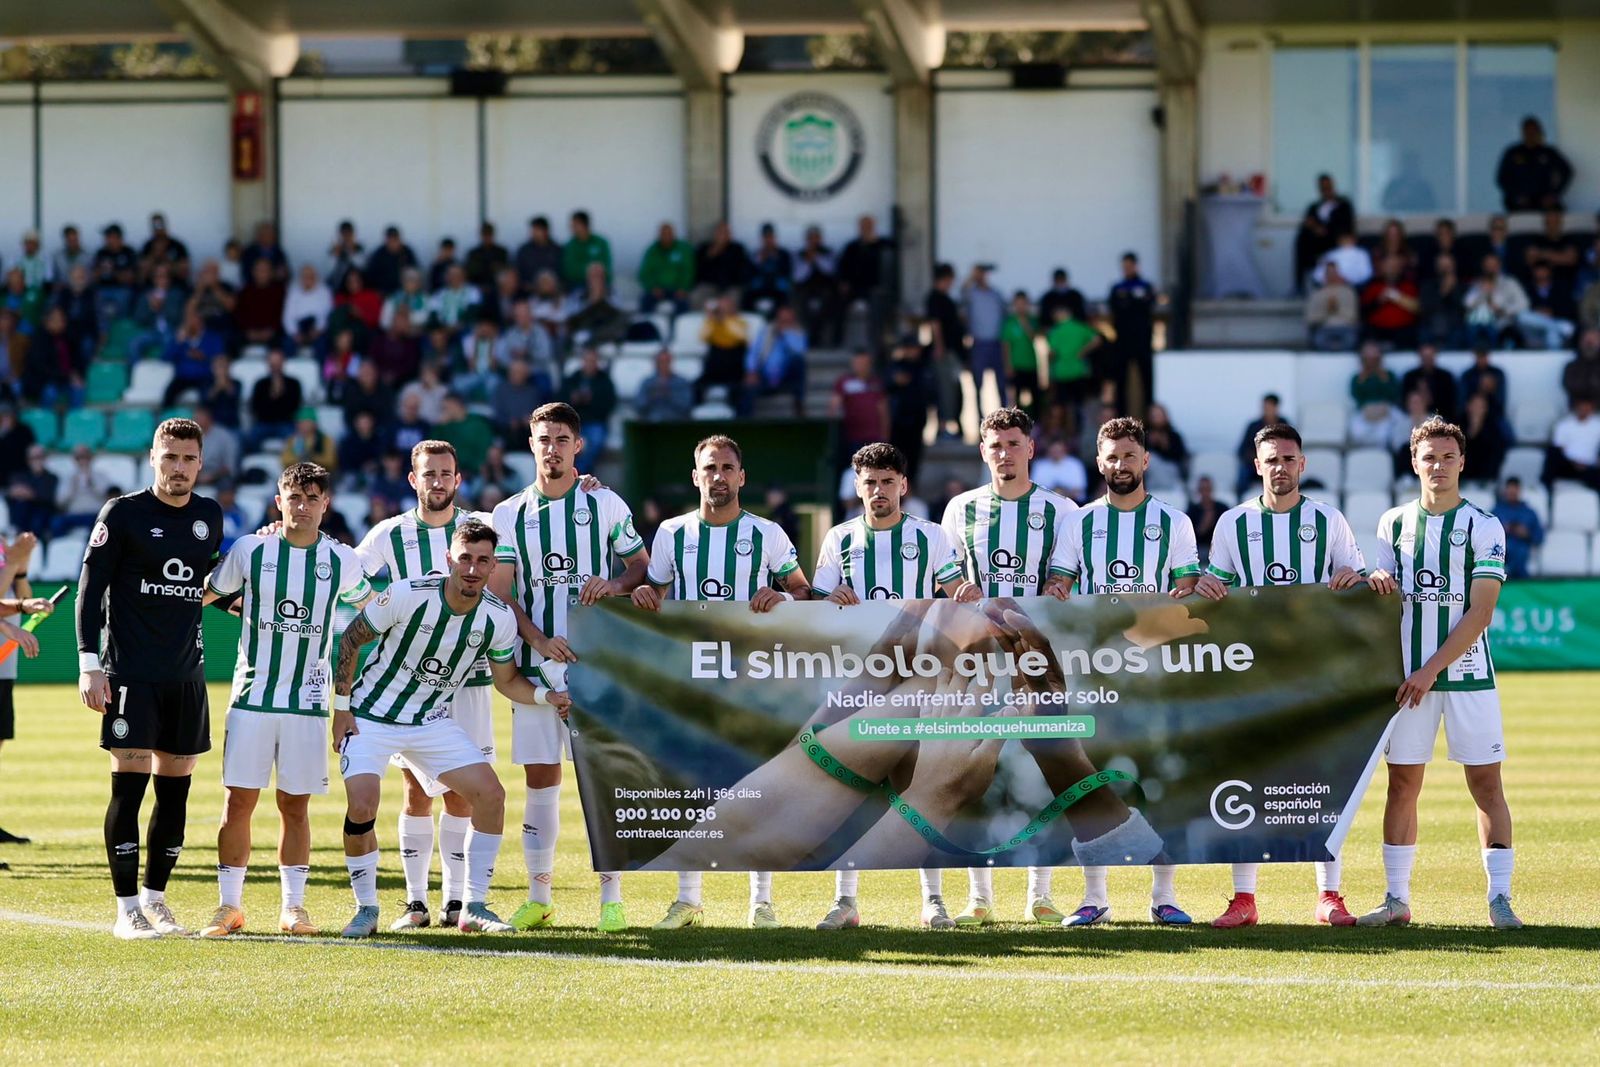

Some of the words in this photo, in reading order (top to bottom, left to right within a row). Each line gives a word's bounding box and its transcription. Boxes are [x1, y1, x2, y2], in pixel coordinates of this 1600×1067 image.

[691, 641, 738, 680] El
[747, 643, 942, 680] símbolo
[953, 649, 1049, 687] que
[1061, 646, 1149, 676] nos
[1161, 641, 1255, 673] une
[118, 686, 128, 715] 1
[827, 690, 887, 708] Nadie
[890, 689, 976, 708] enfrenta
[980, 688, 1000, 706] el
[1003, 687, 1072, 706] cáncer
[1076, 686, 1120, 705] solo
[858, 719, 900, 735] Únete
[902, 725, 911, 735] a
[914, 720, 1087, 737] #elsimboloquehumaniza
[614, 787, 682, 801] Disponibles
[684, 788, 705, 801] 24h
[713, 788, 735, 801] 365
[737, 787, 762, 799] días
[1264, 783, 1331, 796] asociación
[1264, 798, 1322, 813] española
[615, 807, 648, 823] 900
[650, 808, 682, 821] 100
[685, 806, 717, 823] 036
[1264, 813, 1305, 825] contra
[1308, 812, 1319, 824] el
[615, 827, 724, 839] contraelcancer.es
